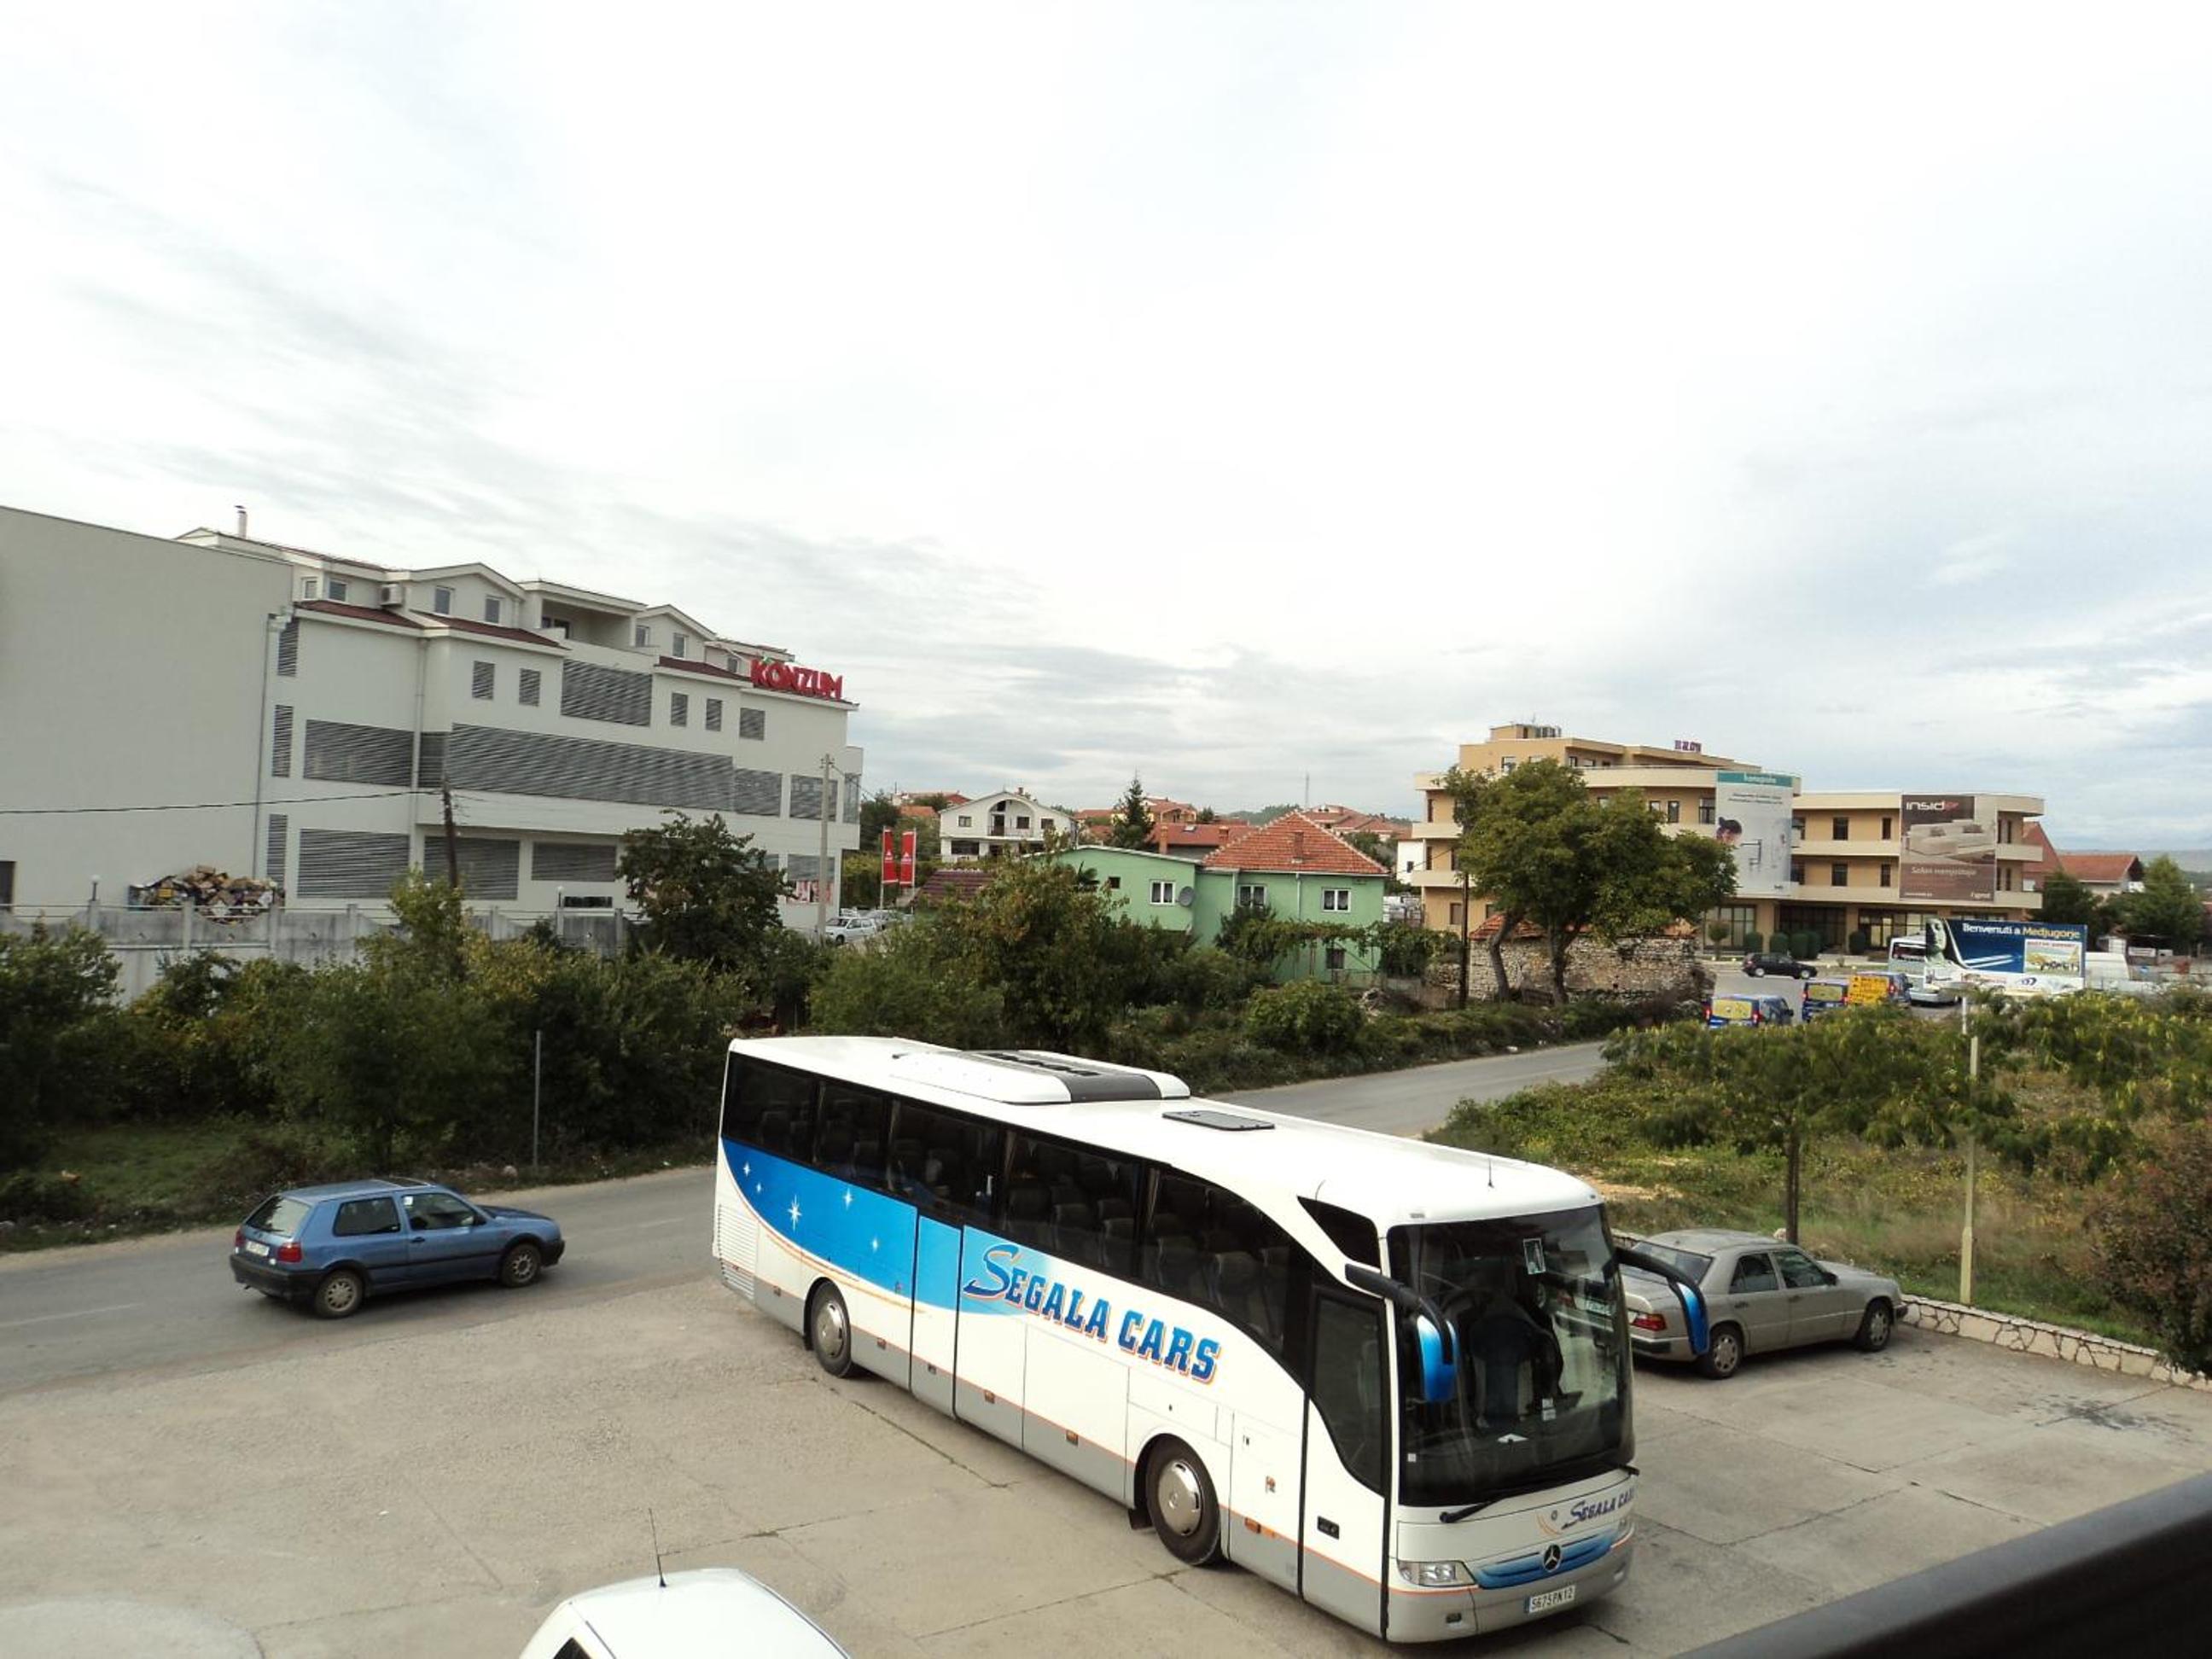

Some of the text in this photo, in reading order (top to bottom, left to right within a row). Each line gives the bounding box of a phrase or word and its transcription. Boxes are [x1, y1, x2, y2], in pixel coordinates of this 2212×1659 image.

[1963, 923, 2012, 934] Benvenuti
[2023, 926, 2081, 940] Medjugorje
[963, 1243, 1220, 1384] SEGALA CARS
